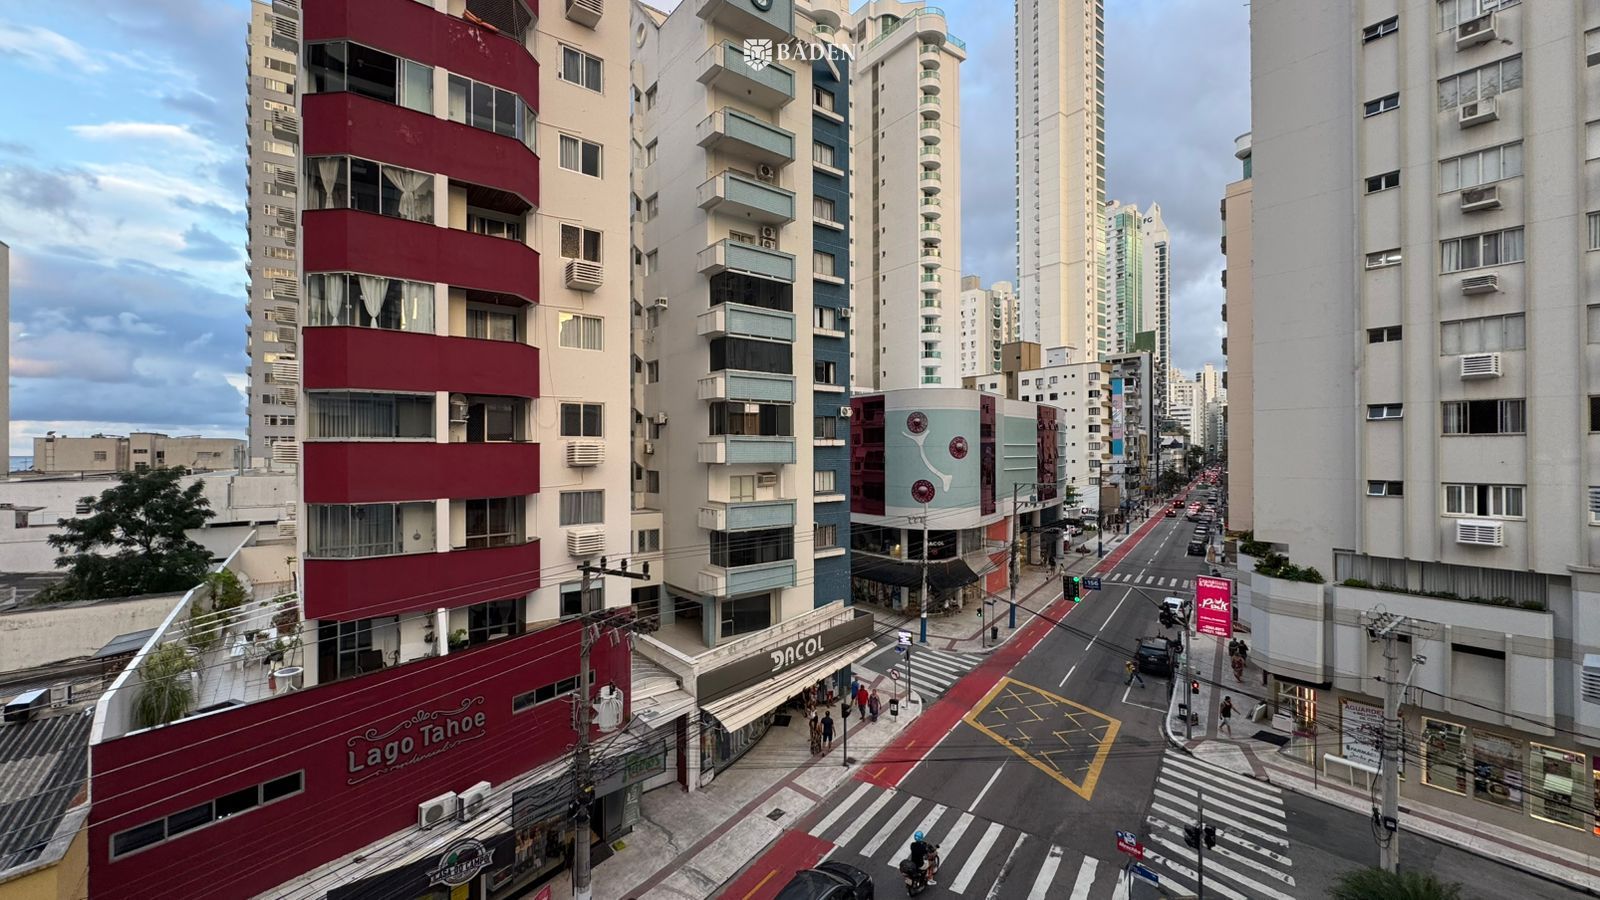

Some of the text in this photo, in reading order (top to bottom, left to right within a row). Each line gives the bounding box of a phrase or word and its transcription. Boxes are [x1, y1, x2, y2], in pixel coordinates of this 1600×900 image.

[770, 635, 824, 672] DACOL
[348, 711, 486, 773] Lago Tahoe
